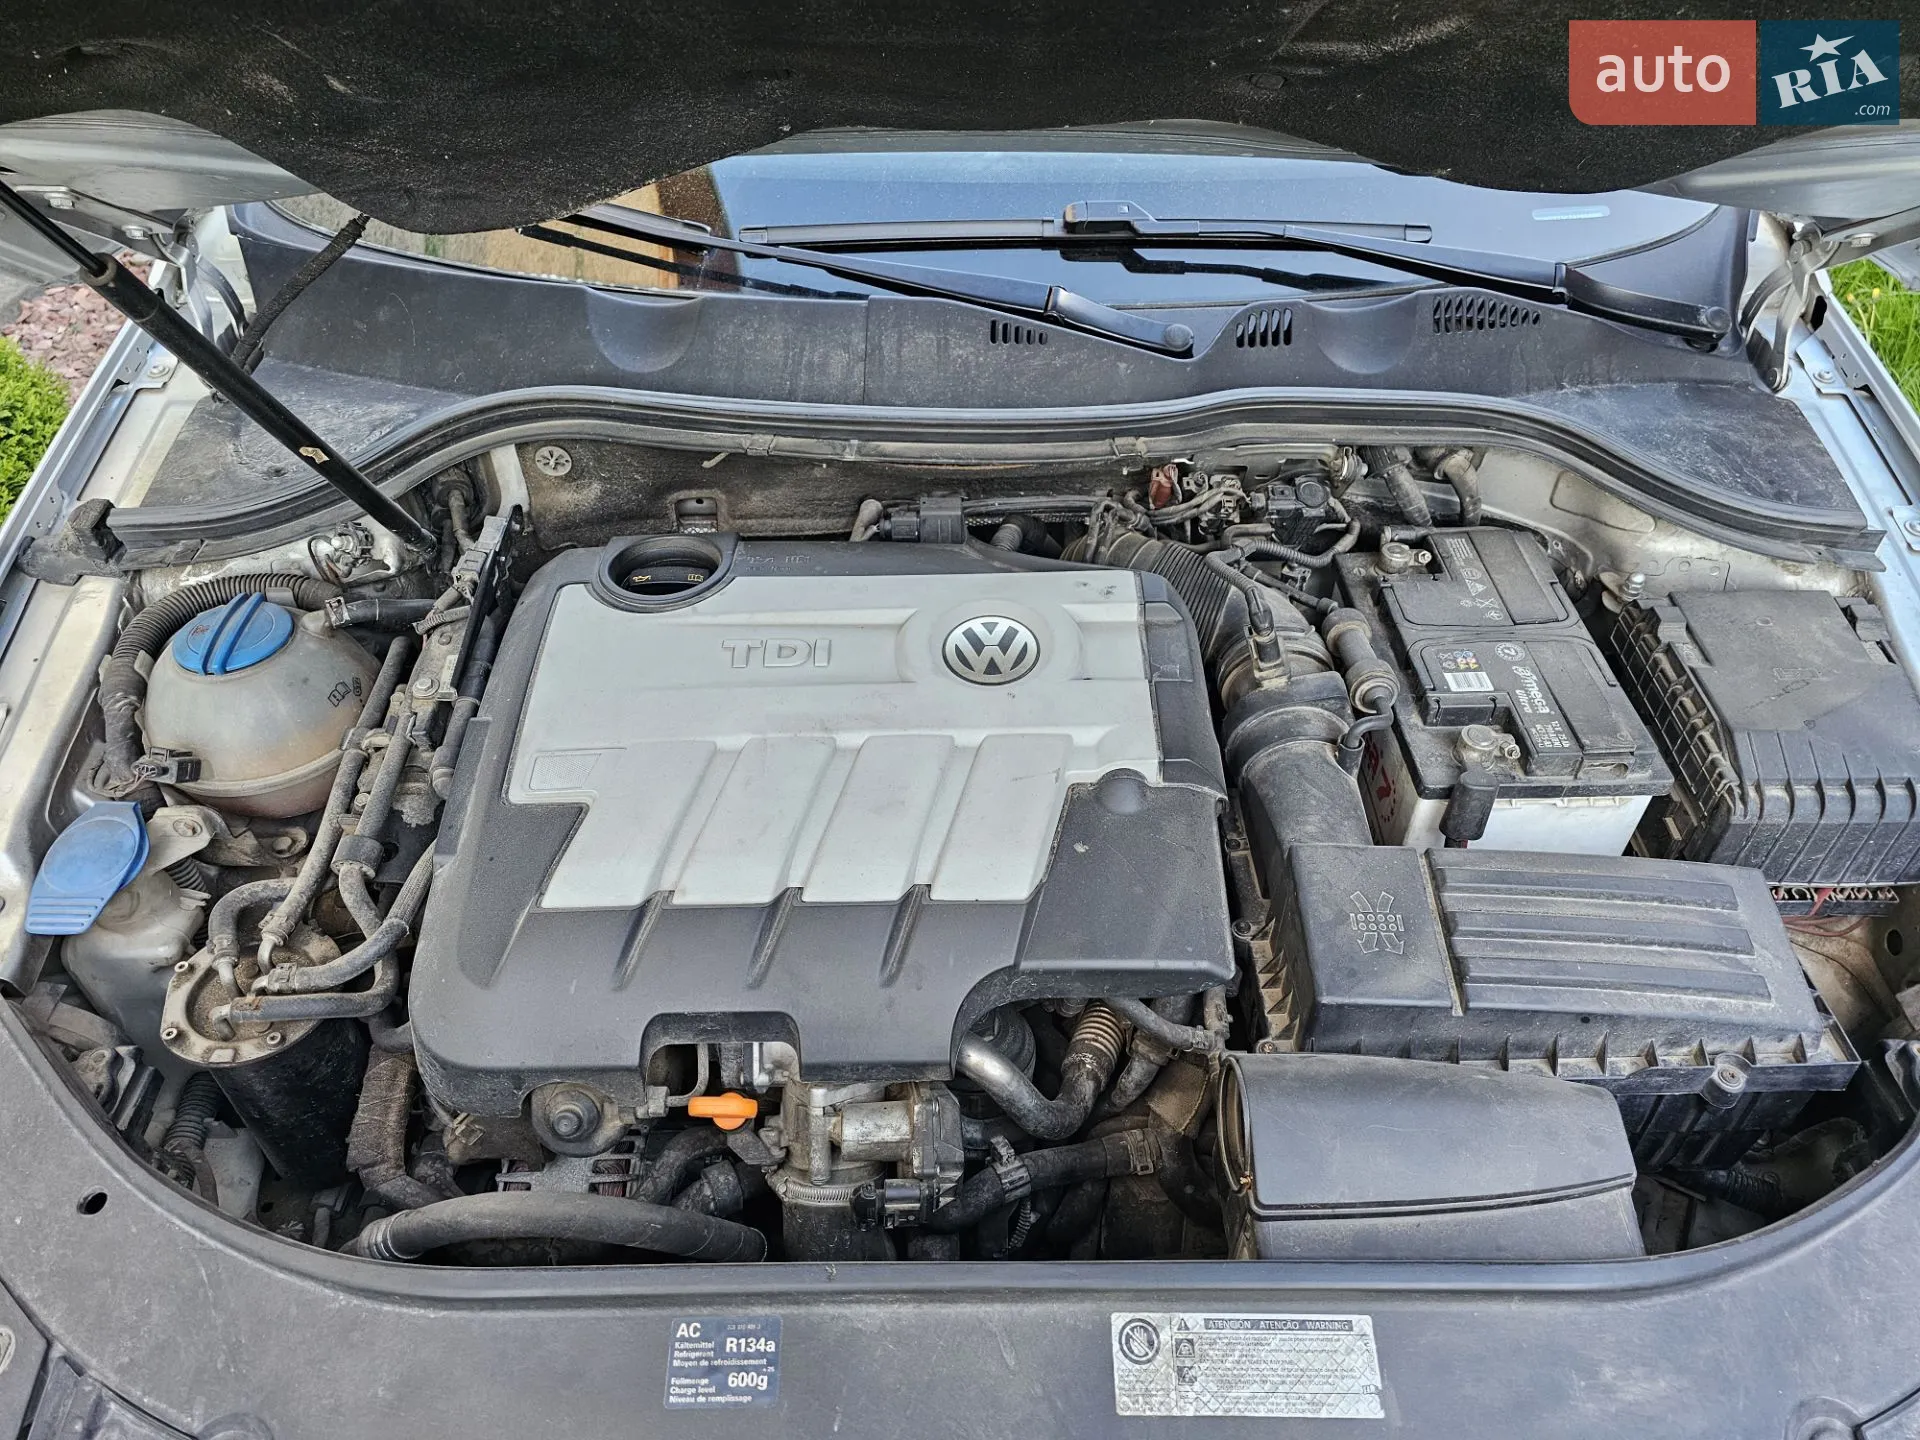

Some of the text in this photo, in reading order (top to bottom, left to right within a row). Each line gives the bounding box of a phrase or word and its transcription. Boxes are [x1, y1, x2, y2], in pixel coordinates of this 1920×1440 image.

[722, 639, 832, 669] TDI
[676, 1323, 701, 1338] AC
[1305, 1320, 1349, 1331] WARNING
[725, 1337, 776, 1353] R134a
[673, 1350, 714, 1359] Refrigerant
[673, 1360, 698, 1368] Moyen
[728, 1372, 768, 1390] 600g
[670, 1386, 696, 1395] Charge
[669, 1395, 695, 1403] Niveau
[707, 1394, 752, 1403] remplissage
